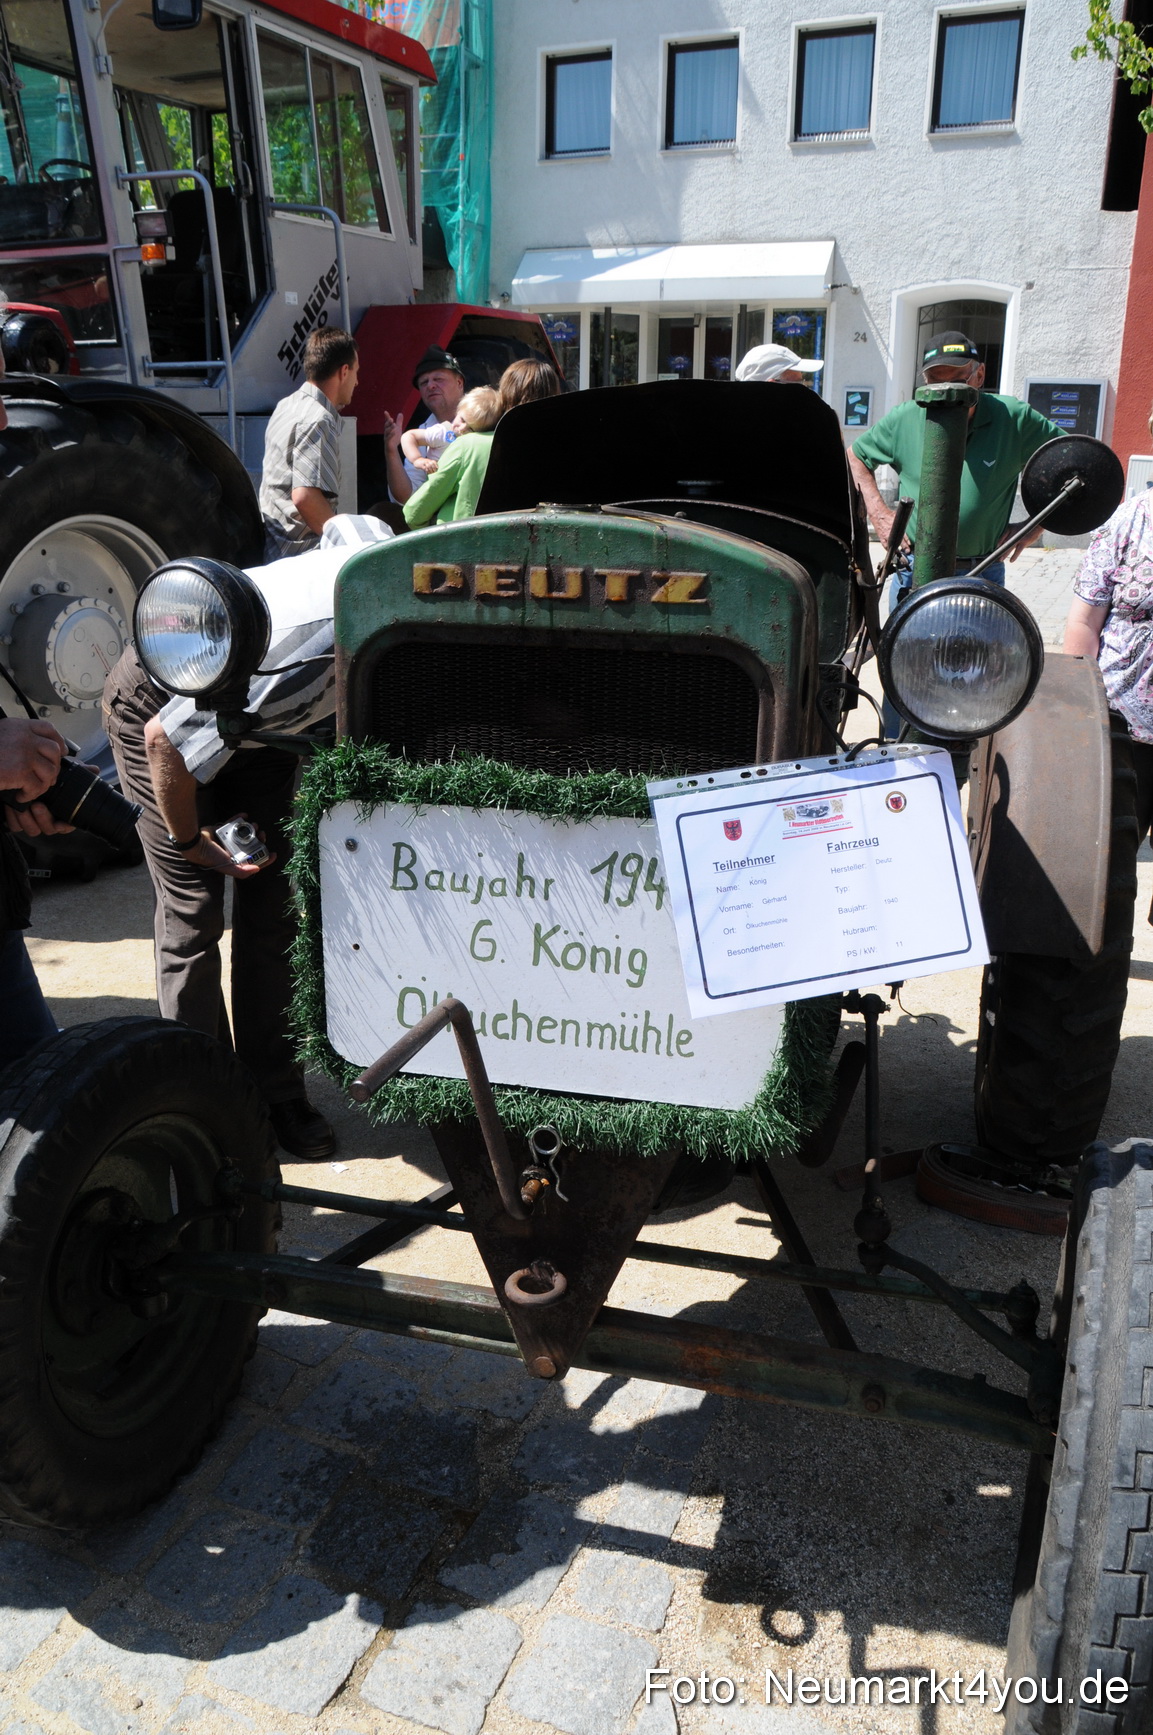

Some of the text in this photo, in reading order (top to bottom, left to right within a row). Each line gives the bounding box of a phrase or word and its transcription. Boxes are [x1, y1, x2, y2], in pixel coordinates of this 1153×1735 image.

[277, 258, 341, 371] Schlüte
[853, 331, 868, 343] 24
[412, 562, 708, 604] DEUTZ
[826, 837, 880, 853] Fahrzeug
[713, 854, 776, 872] Teilnehmer
[830, 857, 893, 874] Hersteller: Deutz
[390, 841, 555, 905] Baujahr
[716, 878, 767, 894] Name: König
[835, 886, 850, 895] Typ:
[719, 895, 788, 914] Vorname: Gerhard
[838, 897, 899, 915] Baujahr: 1940
[723, 917, 788, 936] Ort: Ölkuchenmühle
[842, 925, 878, 936] Hubraum:
[469, 919, 649, 989] G. König
[727, 941, 785, 957] Besonderheiten:
[846, 949, 858, 957] PS
[863, 946, 878, 955] kW:
[396, 974, 695, 1058] Öuchenmühle
